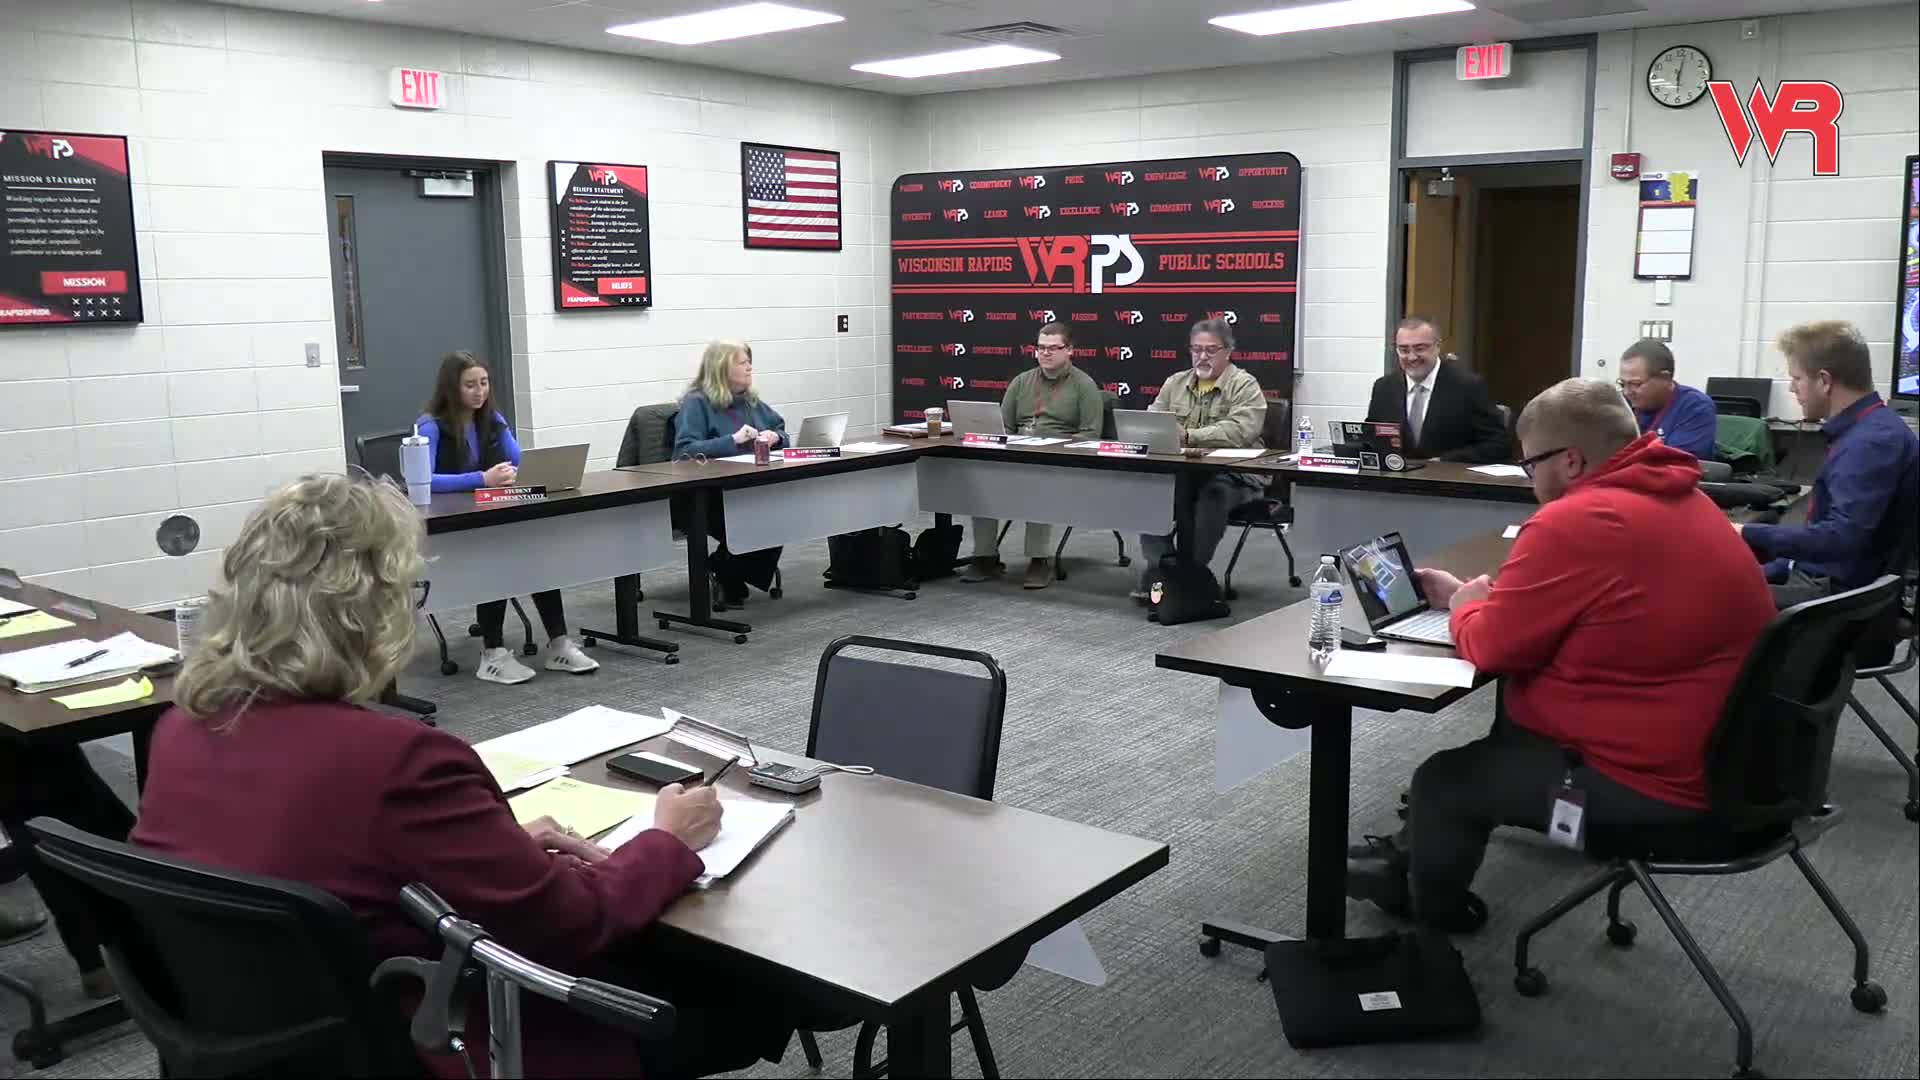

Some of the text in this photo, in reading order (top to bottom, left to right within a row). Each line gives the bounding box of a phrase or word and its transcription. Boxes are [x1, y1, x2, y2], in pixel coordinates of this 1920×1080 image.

[1676, 49, 1686, 57] 12
[1465, 45, 1504, 78] EXIT
[1664, 54, 1672, 62] 11
[1654, 63, 1662, 71] 10
[1698, 60, 1704, 68] 2
[401, 70, 438, 105] EXIT
[1664, 94, 1670, 102] 7
[1686, 92, 1692, 100] 5
[3, 175, 96, 185] MISSION STATEMENT
[970, 179, 1012, 190] COMMITMENT
[1065, 176, 1084, 184] PRIDE
[1238, 166, 1288, 176] OPPORTUNITY
[984, 210, 1008, 219] LEADER
[1252, 200, 1285, 209] SUCCESS
[898, 256, 964, 273] WISCONSIN
[968, 256, 1013, 272] RAPIDS
[1158, 254, 1211, 271] PUBLIC
[1216, 252, 1284, 270] SCHOOLS
[63, 277, 106, 287] MISSION
[611, 282, 632, 290] BELIEFS
[1072, 312, 1098, 321] PASSION
[1152, 350, 1176, 358] LEADER
